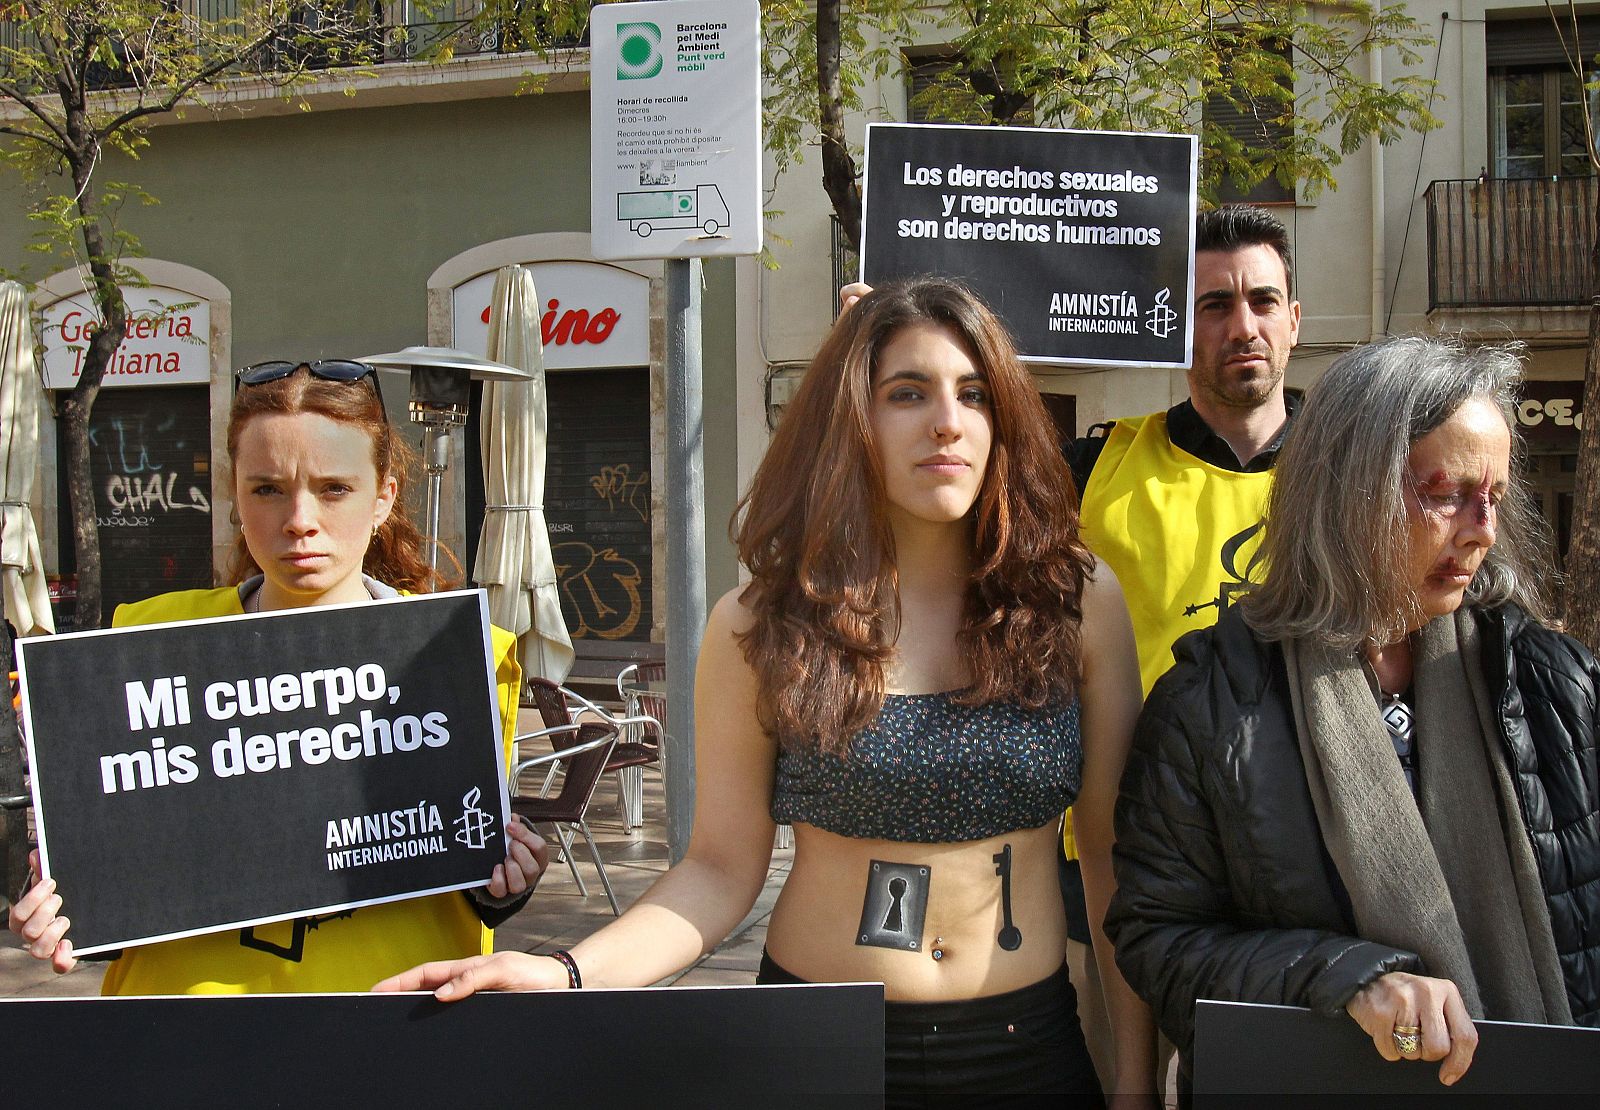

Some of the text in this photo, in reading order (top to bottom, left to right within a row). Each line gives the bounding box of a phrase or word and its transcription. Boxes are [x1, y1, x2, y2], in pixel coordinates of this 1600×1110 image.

[676, 22, 728, 32] Barcelona
[676, 32, 720, 44] pel Medi
[677, 42, 720, 52] Ambient
[677, 52, 726, 62] Punt verd
[677, 62, 706, 72] mòbil
[617, 98, 641, 106] Horari
[654, 95, 689, 104] recollida
[617, 107, 650, 115] Dimecres
[617, 129, 651, 138] Recordeu
[651, 129, 666, 137] que
[903, 162, 1159, 194] Los derechos sexuales
[941, 193, 1118, 218] y reproductivos
[897, 217, 1161, 246] son derechos humanos
[1049, 290, 1138, 318] AMNISTÍA
[481, 298, 622, 346] ino
[1048, 317, 1139, 335] INTERNACIONAL
[125, 662, 401, 731] Mi cuerpo,
[100, 711, 450, 794] mis derechos
[325, 800, 444, 849] AMNISTÍA
[327, 835, 448, 871] INTERNACIONAL
